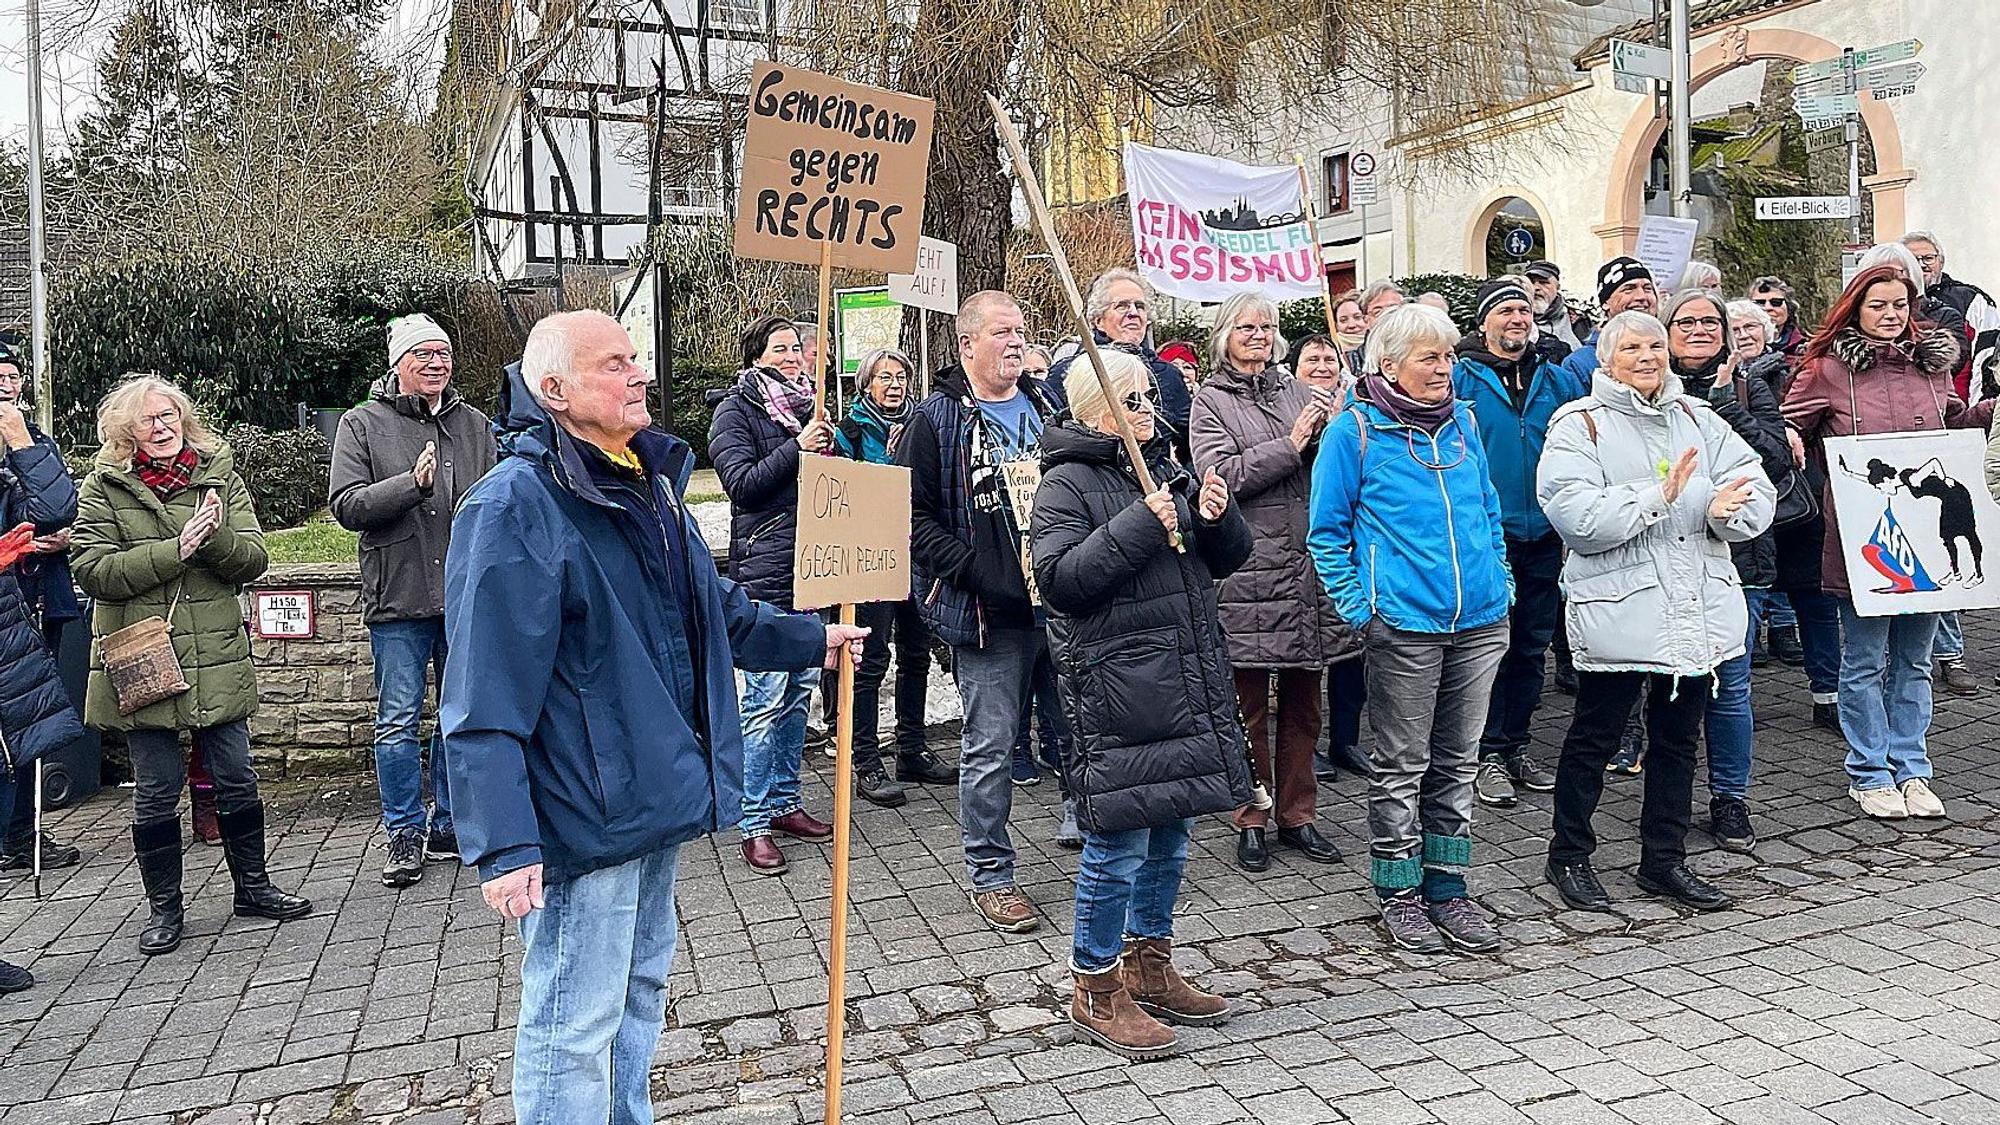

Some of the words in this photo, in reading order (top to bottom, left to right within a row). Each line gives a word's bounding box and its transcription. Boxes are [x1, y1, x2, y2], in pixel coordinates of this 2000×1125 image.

[754, 70, 917, 145] Gemeinsam
[1808, 131, 1842, 149] Vorburg
[790, 148, 880, 193] gegen
[756, 189, 903, 250] RECHTS
[1771, 201, 1831, 215] Eifel-Blick
[919, 246, 943, 270] EHT
[1006, 465, 1037, 487] Keine
[813, 472, 851, 519] OPA
[800, 544, 850, 580] GEGEN
[856, 546, 897, 574] RECHTS
